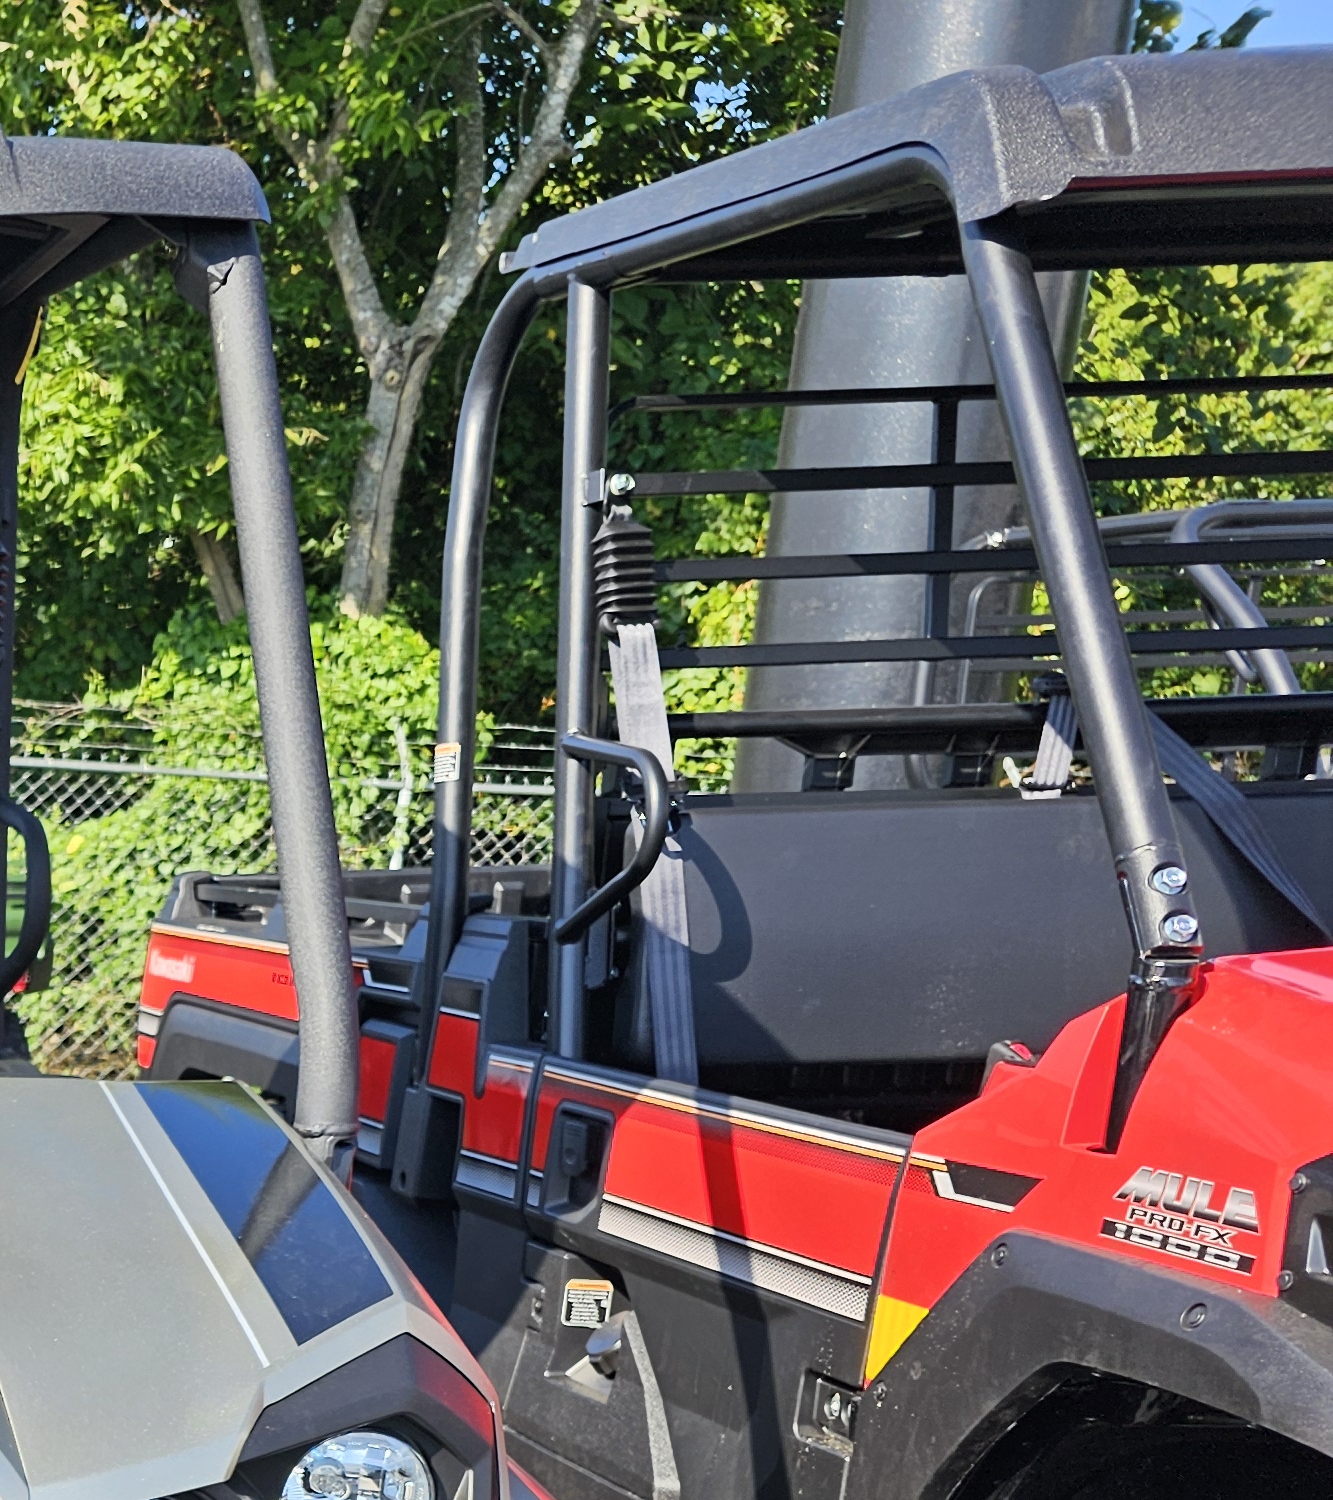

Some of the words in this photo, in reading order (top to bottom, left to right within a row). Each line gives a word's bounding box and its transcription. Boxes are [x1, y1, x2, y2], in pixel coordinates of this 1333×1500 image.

[1113, 1166, 1261, 1236] MULE
[1114, 1222, 1241, 1270] 1000
[1126, 1206, 1238, 1248] PRO-FX
